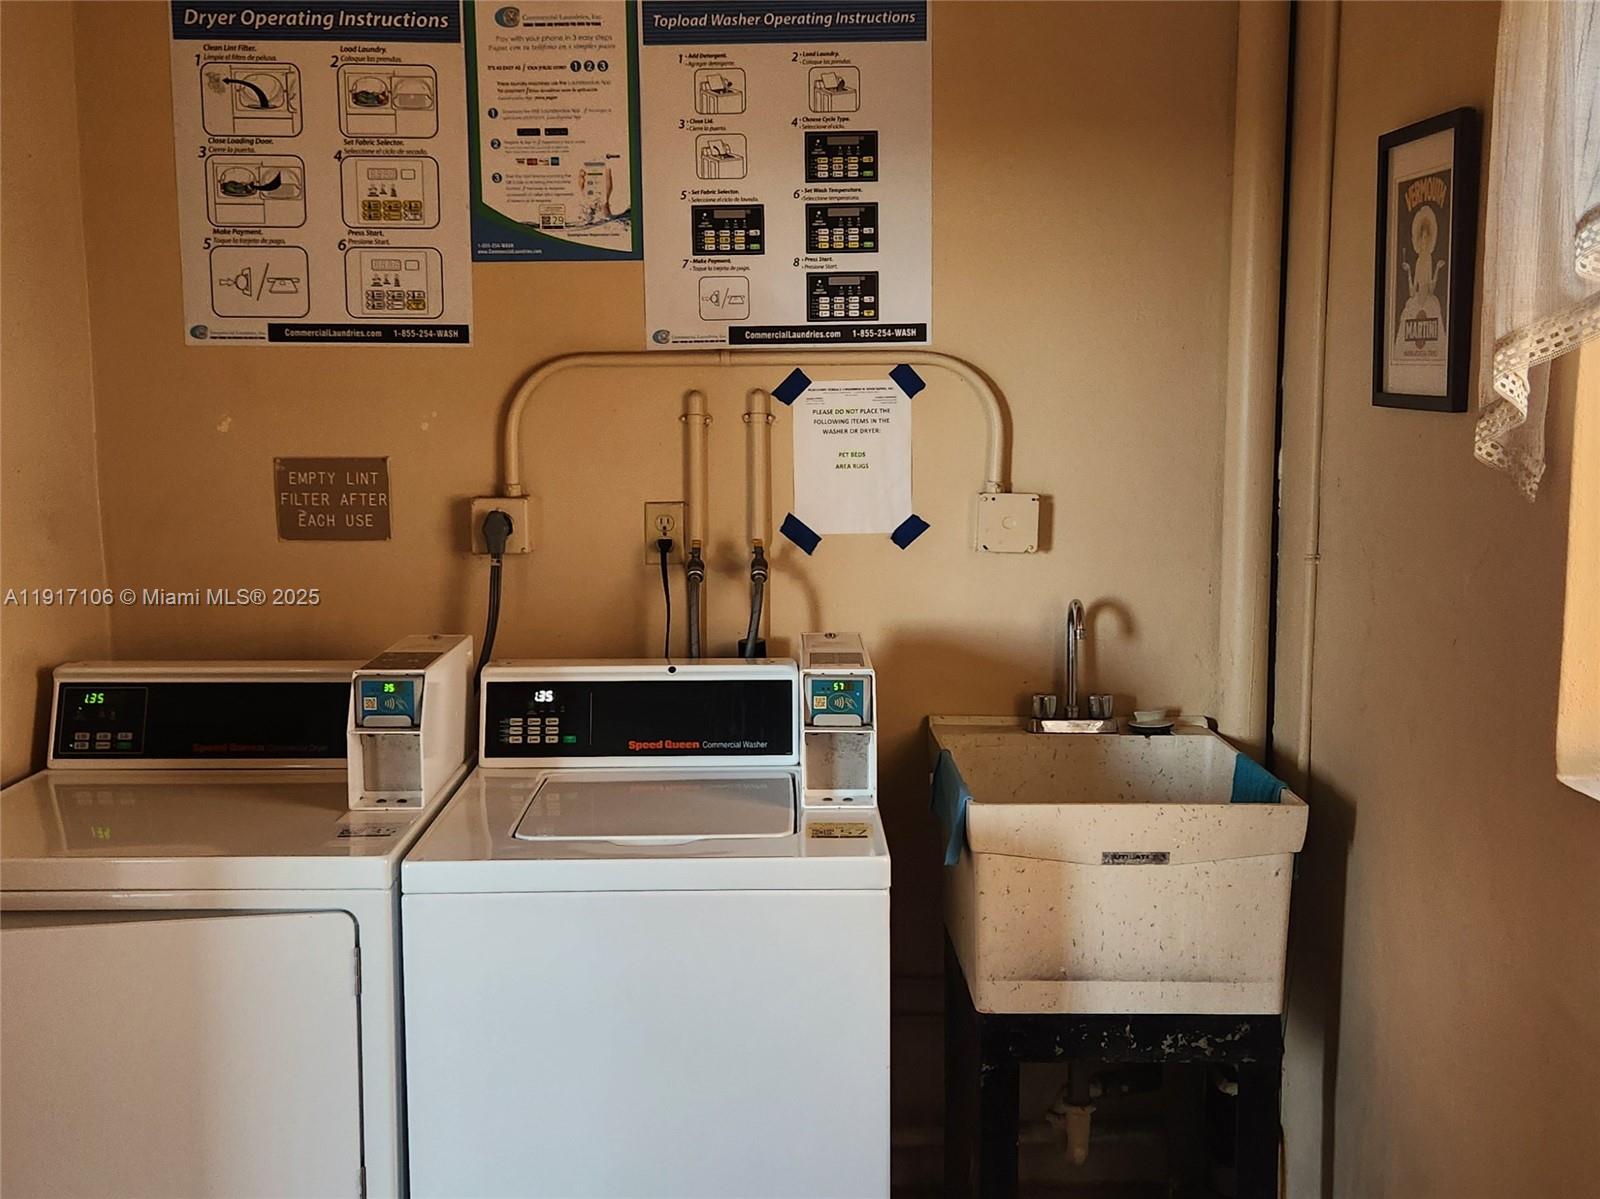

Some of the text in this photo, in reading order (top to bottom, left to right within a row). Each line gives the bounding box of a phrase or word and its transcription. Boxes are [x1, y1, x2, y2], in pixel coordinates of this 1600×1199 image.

[184, 9, 449, 31] Dryer Operating Instructions
[653, 10, 916, 30] Topload Washer Operating Instructions
[195, 54, 201, 66] 1
[330, 55, 339, 68] 2
[792, 52, 799, 63] 2
[679, 119, 686, 130] 3
[792, 117, 799, 128] 4
[198, 146, 206, 158] 3
[334, 150, 342, 162] 4
[680, 190, 688, 200] 5
[793, 189, 800, 199] 6
[203, 237, 212, 250] 5
[338, 239, 347, 251] 6
[682, 259, 689, 269] 7
[793, 257, 800, 268] 8
[284, 328, 383, 339] CommercialLaundries.com
[393, 328, 459, 339] 1-855-254-WASH
[744, 329, 842, 340] CommercialLaundries.com
[852, 327, 917, 338] 1-855-254-WASH
[288, 471, 380, 486] EMPTY LINT
[280, 492, 388, 507] FILTER AFTER
[298, 513, 374, 528] EACH USE
[628, 739, 769, 751] Speed Queen Commercial Washer
